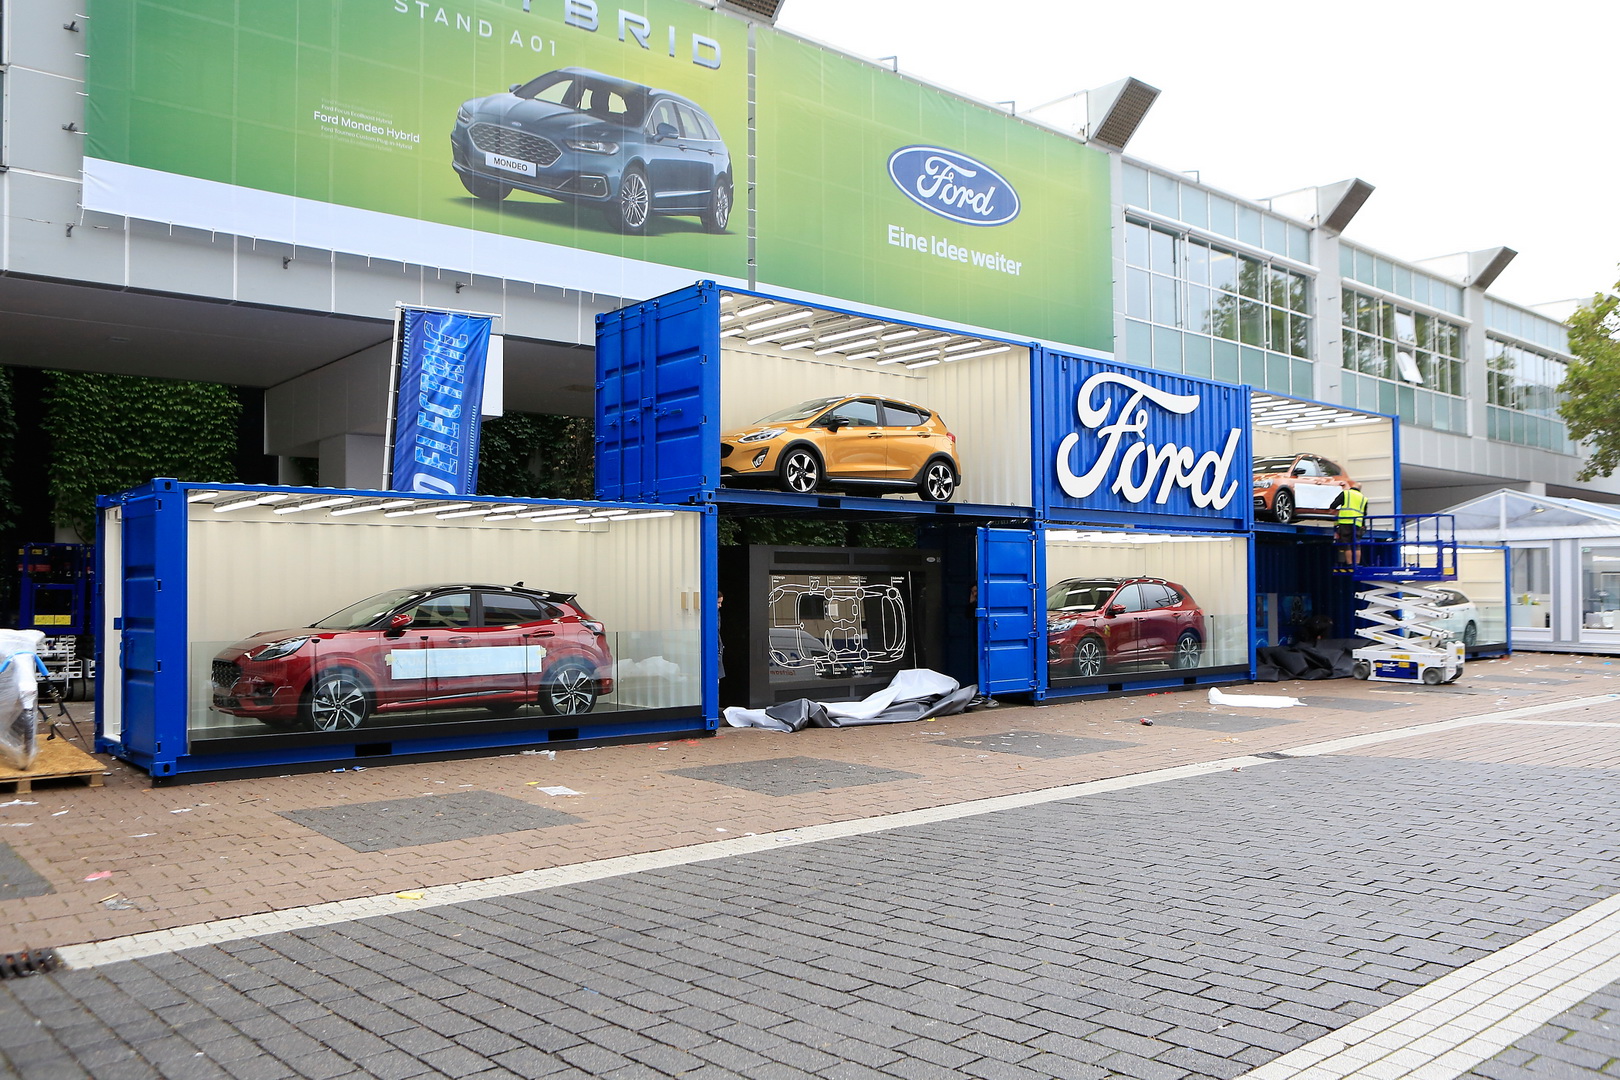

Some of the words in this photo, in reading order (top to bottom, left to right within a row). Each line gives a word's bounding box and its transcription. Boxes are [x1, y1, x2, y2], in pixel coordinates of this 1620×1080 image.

[394, 0, 493, 38] STAND
[509, 29, 556, 57] A01
[523, 0, 721, 70] BRID
[314, 111, 339, 125] Ford
[341, 117, 384, 135] Mondeo
[386, 126, 420, 143] Hybrid
[321, 104, 334, 112] Ford
[493, 157, 528, 172] MONDEO
[916, 156, 995, 216] Ford
[888, 224, 928, 252] Eine
[931, 235, 968, 263] Idee
[971, 250, 1022, 276] weiter
[415, 320, 468, 475] ELECTRIC
[1056, 371, 1242, 510] Ford
